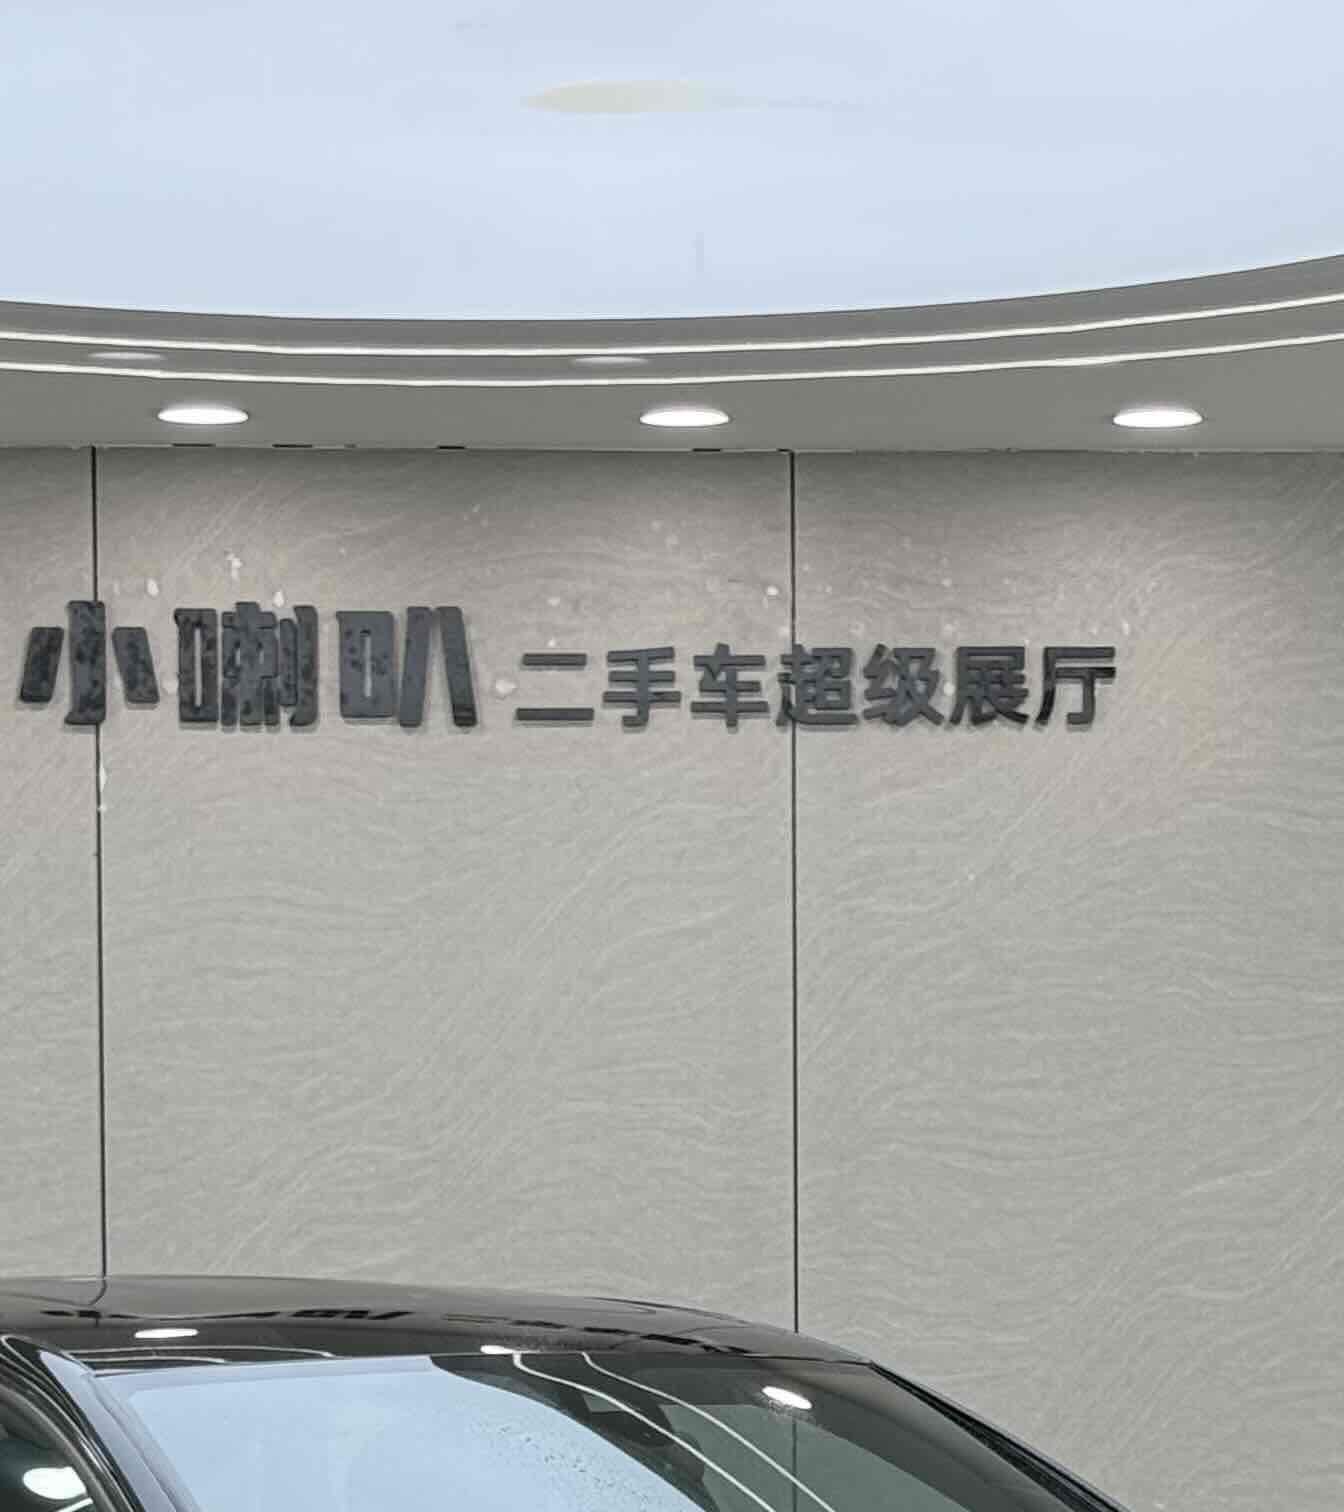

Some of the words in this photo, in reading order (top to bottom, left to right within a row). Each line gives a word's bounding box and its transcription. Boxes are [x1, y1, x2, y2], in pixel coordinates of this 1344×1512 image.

[18, 600, 478, 727] 小喇叭
[514, 642, 1117, 728] 二手车超级展厅
